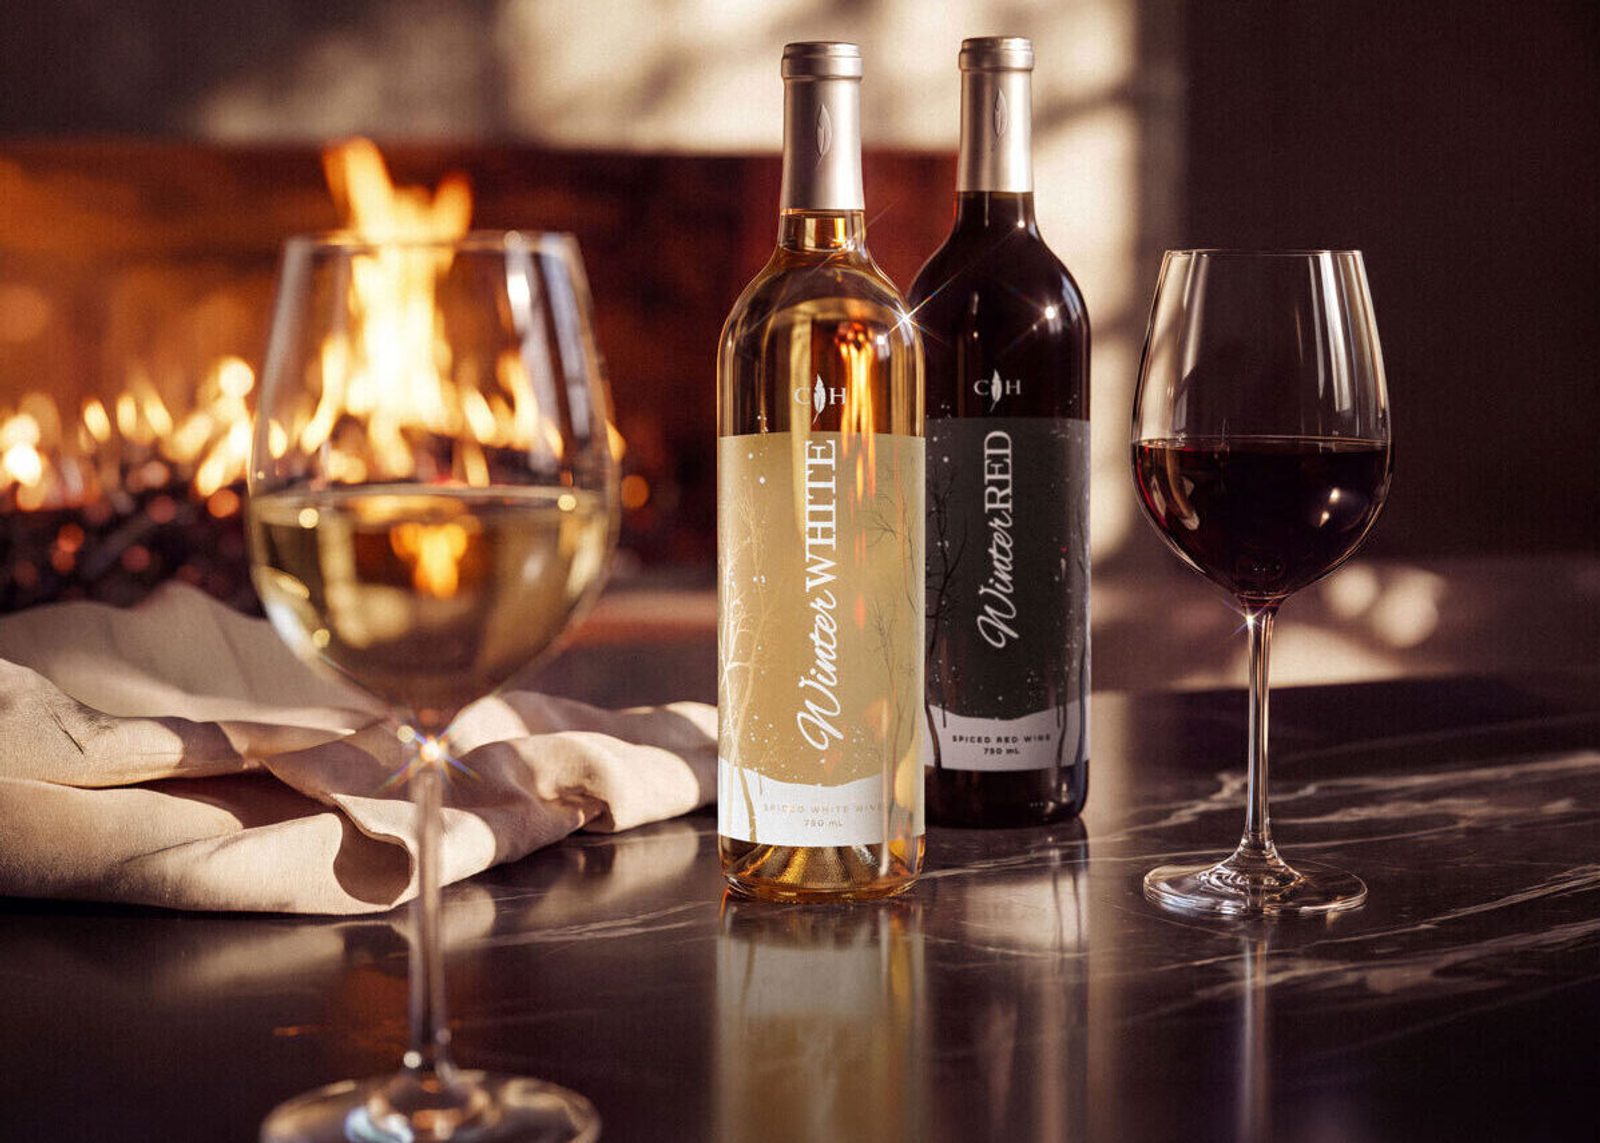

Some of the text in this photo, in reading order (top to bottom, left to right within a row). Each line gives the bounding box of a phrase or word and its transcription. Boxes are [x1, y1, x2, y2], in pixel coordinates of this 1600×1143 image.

[796, 439, 844, 750] Winter WHITE
[976, 430, 1019, 648] Winter RED
[952, 733, 1051, 744] SPICED RED WINE
[983, 746, 1003, 755] 750
